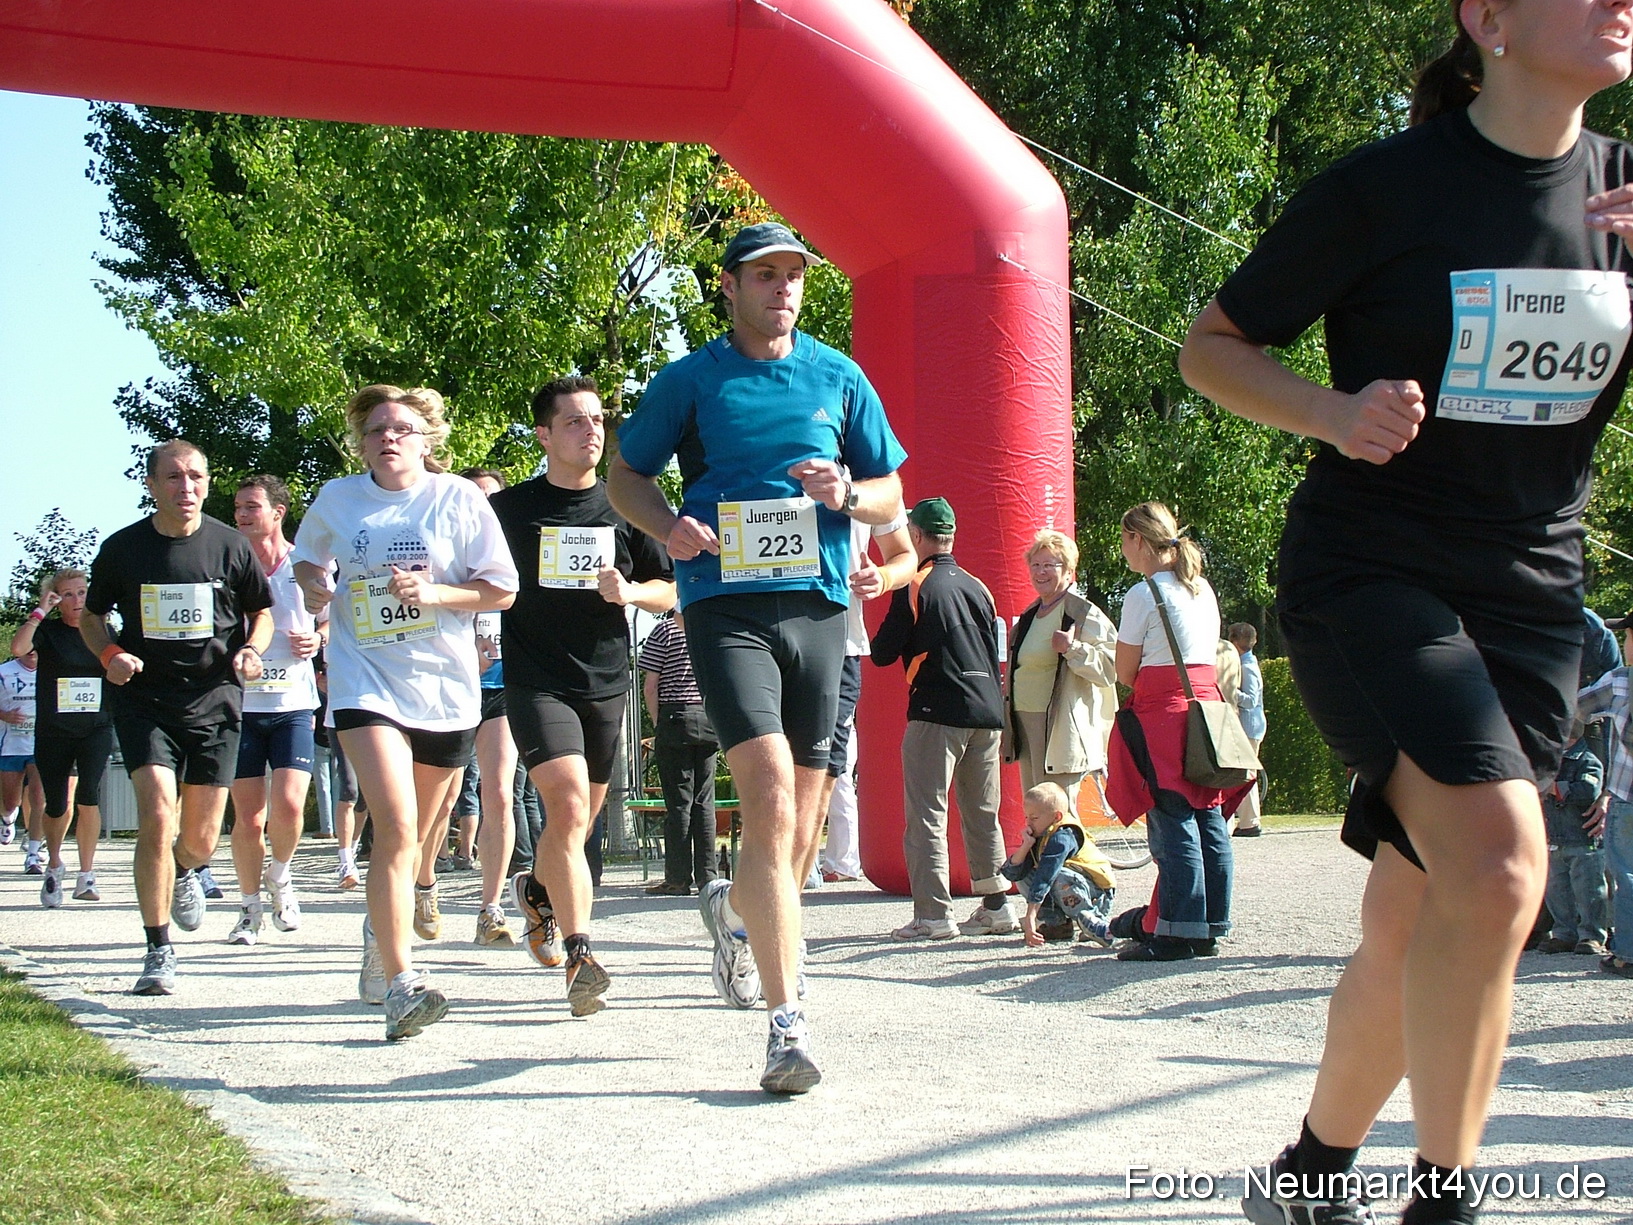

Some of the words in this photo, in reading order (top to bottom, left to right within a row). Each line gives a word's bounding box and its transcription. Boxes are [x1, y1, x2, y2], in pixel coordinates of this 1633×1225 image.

[1506, 284, 1566, 314] Irene
[1460, 329, 1473, 350] D
[1499, 340, 1612, 381] 2649
[1440, 396, 1512, 415] BOCK
[746, 508, 799, 525] Juergen
[561, 532, 597, 546] Jochen
[724, 533, 731, 545] D
[758, 533, 804, 558] 223
[386, 553, 429, 561] 16.09.2007
[568, 554, 604, 572] 324
[782, 563, 819, 574] PFLEIDERER
[160, 589, 184, 601] Hans
[368, 584, 392, 598] Ron
[168, 608, 202, 624] 486
[380, 603, 421, 625] 946
[262, 668, 287, 680] 332
[74, 692, 96, 703] 482
